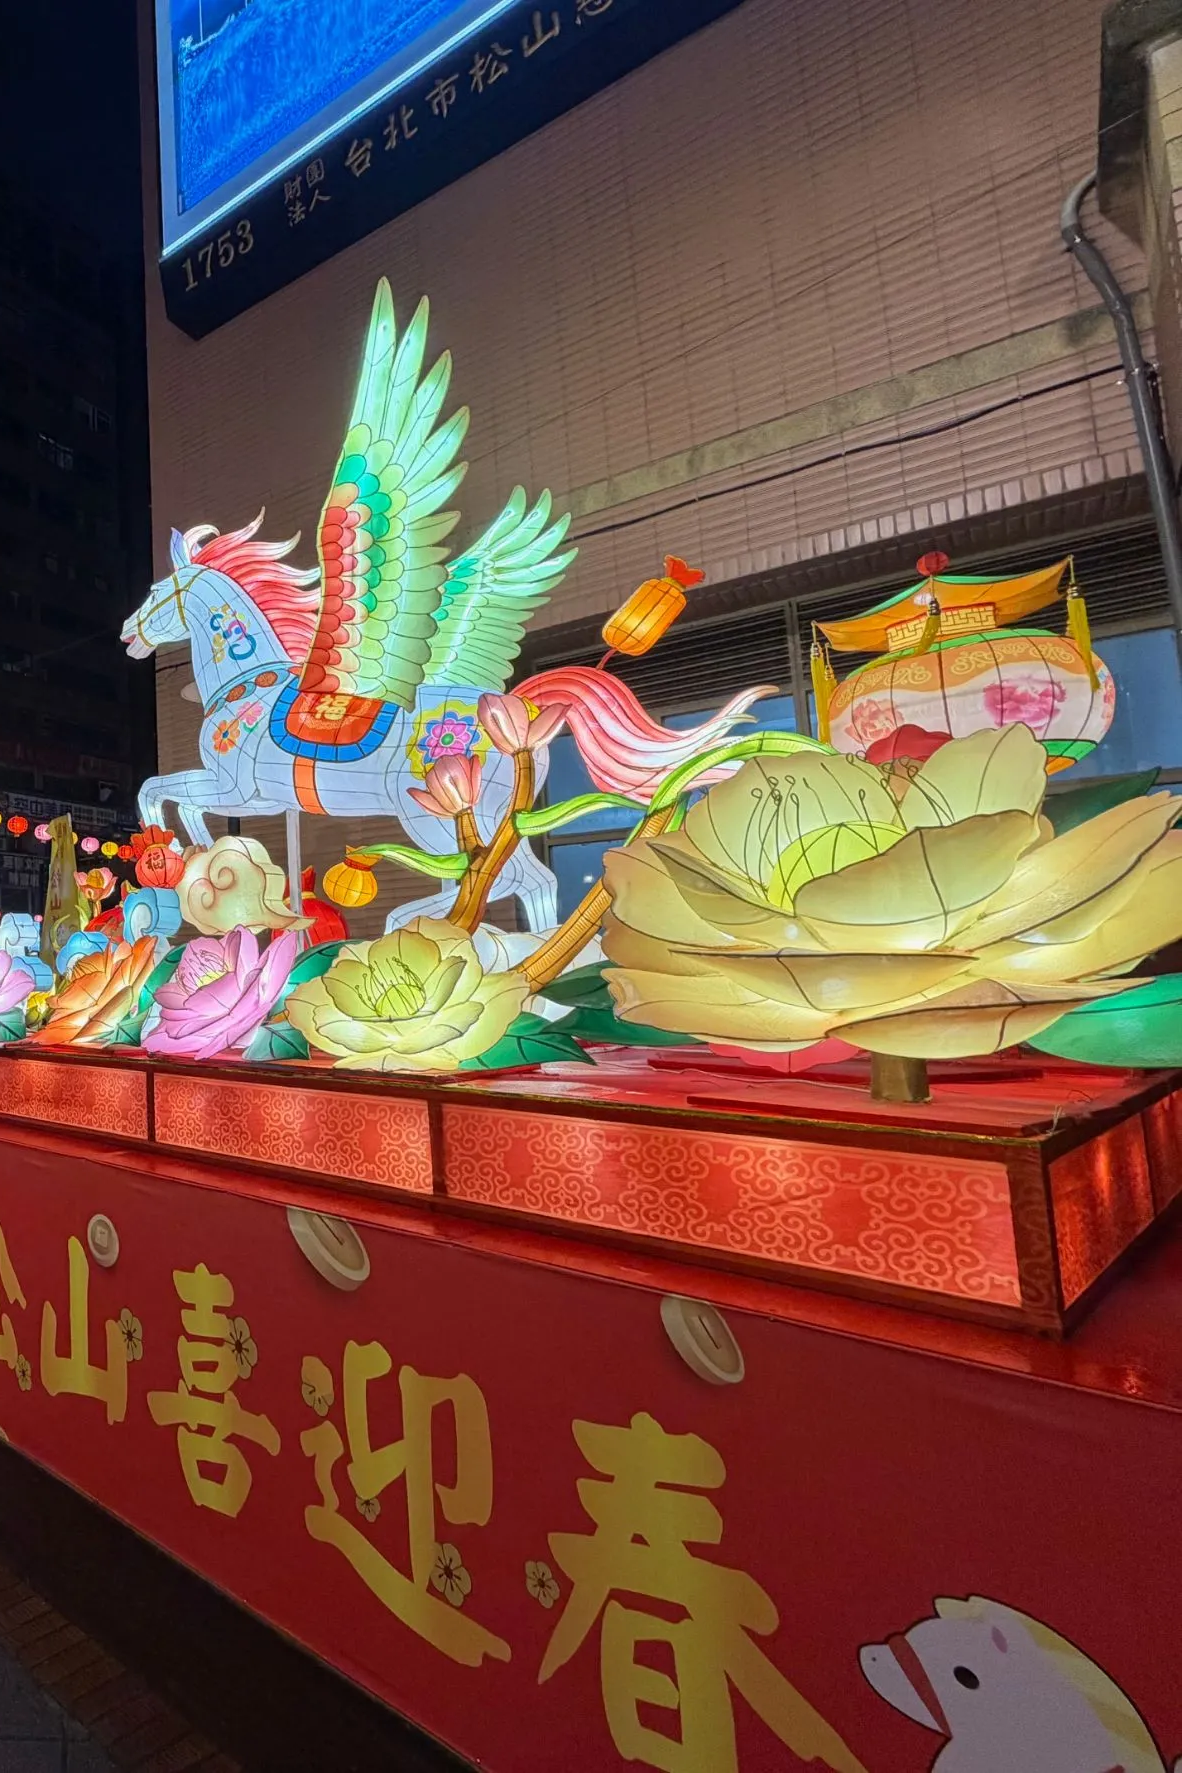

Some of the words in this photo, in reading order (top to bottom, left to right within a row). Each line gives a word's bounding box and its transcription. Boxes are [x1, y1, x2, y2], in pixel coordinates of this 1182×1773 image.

[288, 190, 331, 226] 法人
[182, 219, 254, 292] 1753
[315, 693, 353, 721] 福
[145, 851, 164, 871] 福
